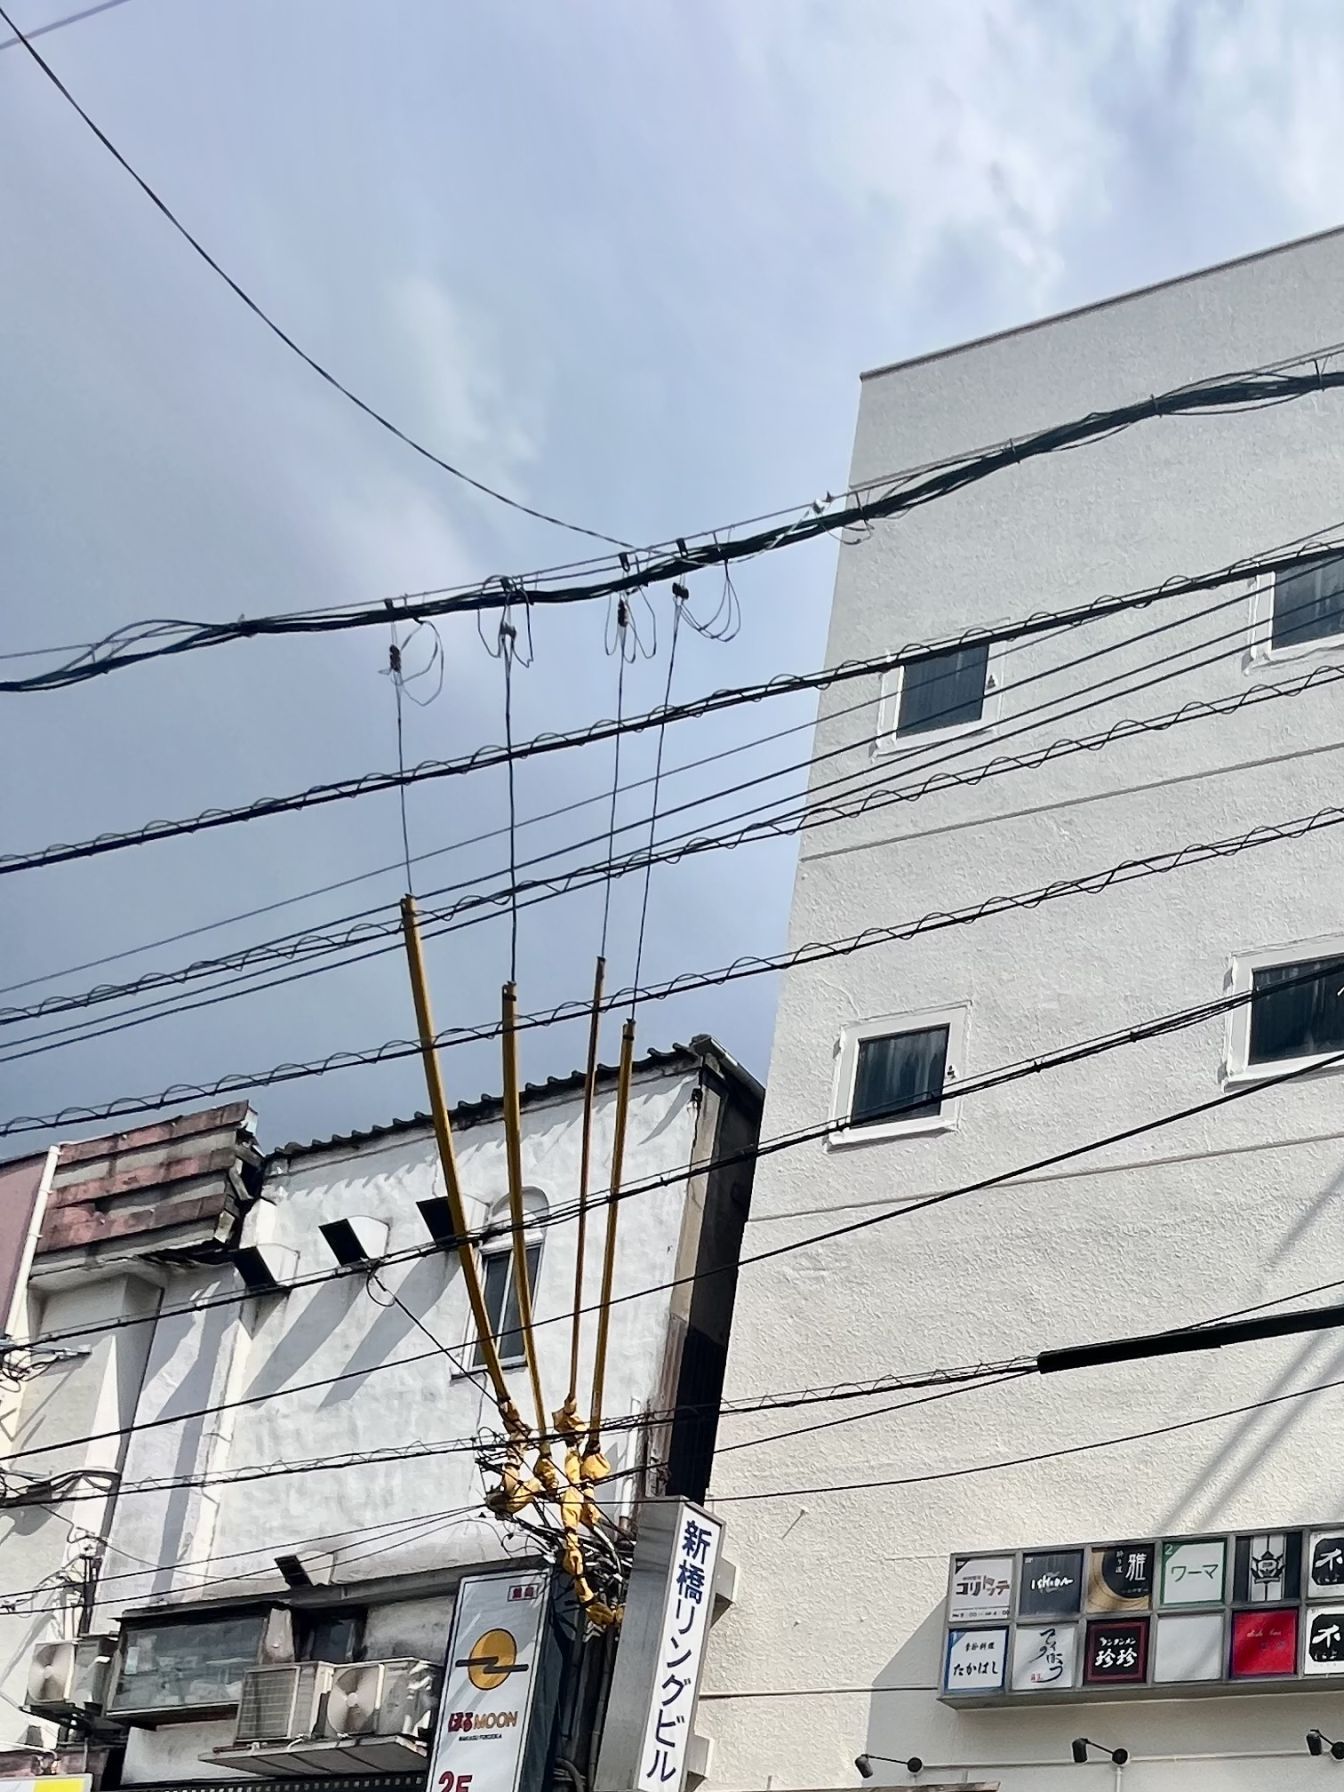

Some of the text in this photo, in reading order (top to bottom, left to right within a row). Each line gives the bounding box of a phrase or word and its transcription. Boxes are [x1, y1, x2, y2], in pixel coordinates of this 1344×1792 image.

[1164, 1544, 1173, 1555] 2
[1125, 1553, 1147, 1582] 雅
[1171, 1563, 1219, 1582] ワーマ
[646, 1519, 712, 1783] 新橋リングビル
[1094, 1648, 1138, 1669] 珍珍
[953, 1661, 998, 1676] たかはし
